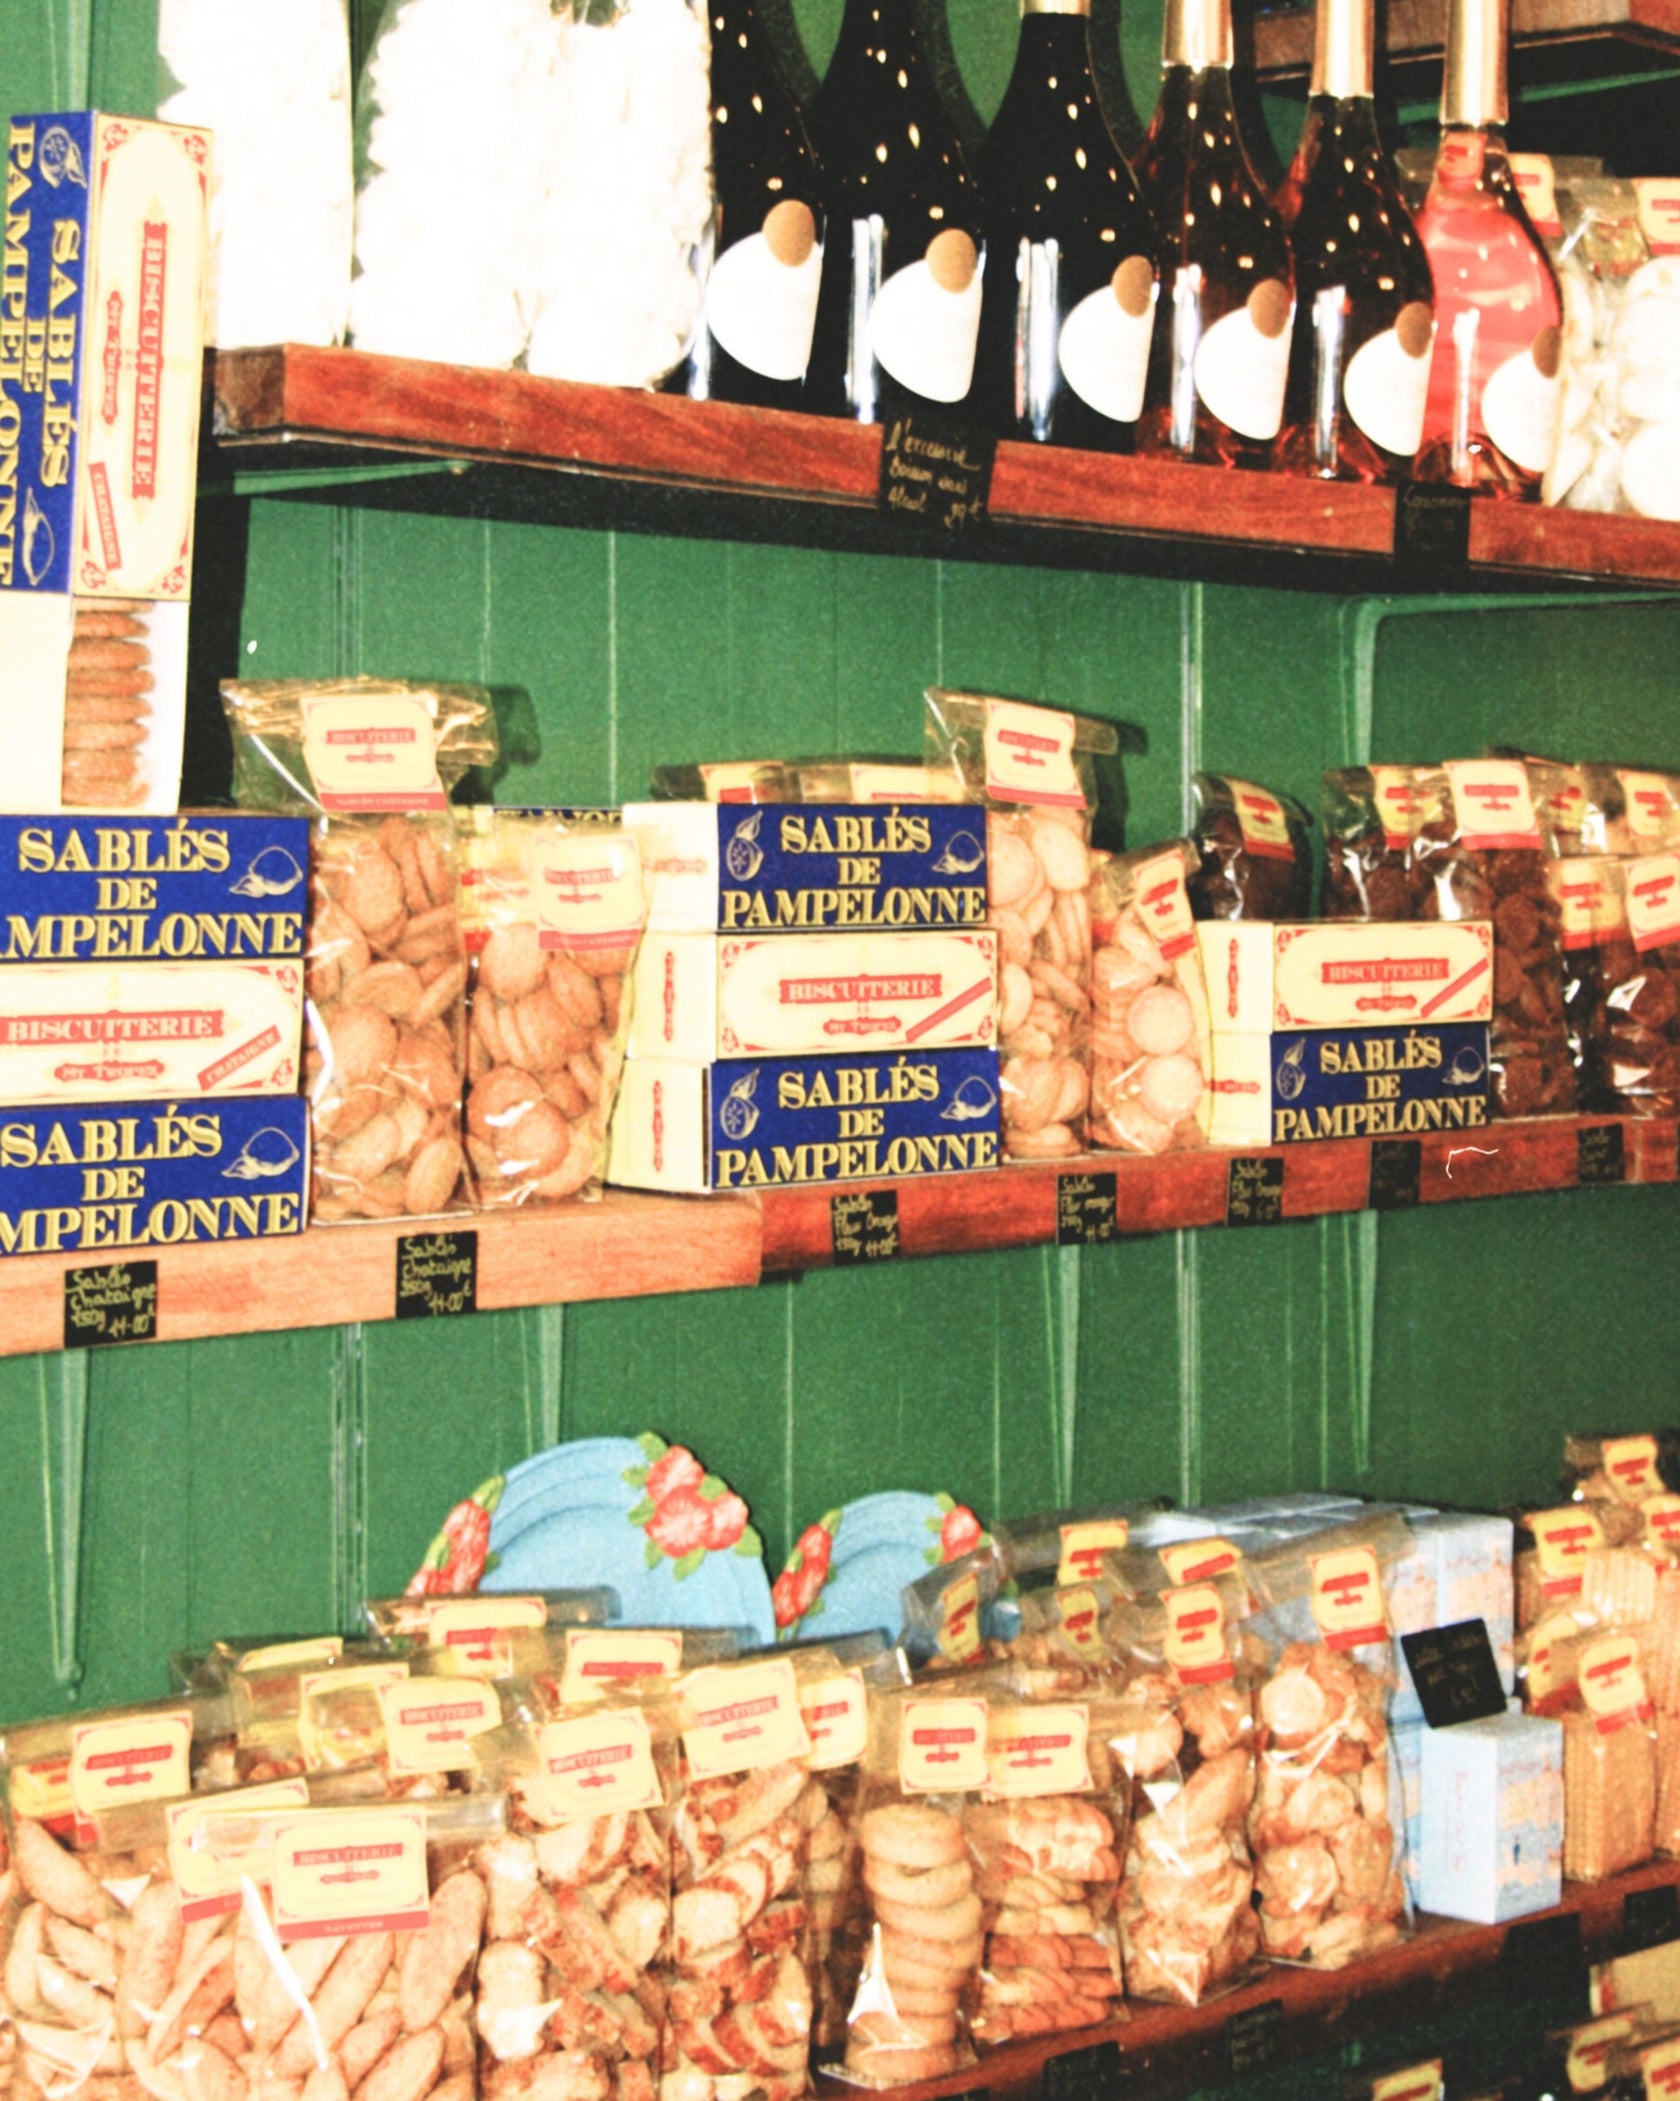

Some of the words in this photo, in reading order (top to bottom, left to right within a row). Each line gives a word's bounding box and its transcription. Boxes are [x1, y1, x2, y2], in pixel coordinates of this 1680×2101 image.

[0, 122, 35, 586] PAMPELONNE
[23, 316, 46, 393] DE
[41, 219, 80, 487] SABLÉS
[136, 236, 164, 488] BISCUITERIE
[18, 818, 231, 873] SABLÉS
[780, 807, 932, 854] SABLÉS
[96, 877, 157, 910] DE
[838, 857, 881, 885] DE
[721, 887, 986, 928] PAMPELONNE
[0, 913, 302, 959] MPELONNE
[788, 978, 934, 999] BISCUITERIE
[1329, 962, 1443, 981] BISCUITERIE
[7, 1015, 213, 1041] BISCUITERIE
[1319, 1029, 1443, 1075] SABLÉS
[777, 1056, 940, 1109] SABLÉS
[1366, 1075, 1401, 1099] DE
[1, 1104, 222, 1168] SABLÉS
[838, 1109, 884, 1138] DE
[1274, 1095, 1486, 1141] PAMPELONNE
[716, 1131, 997, 1188] PAMPELONNE
[82, 1167, 145, 1201] DE
